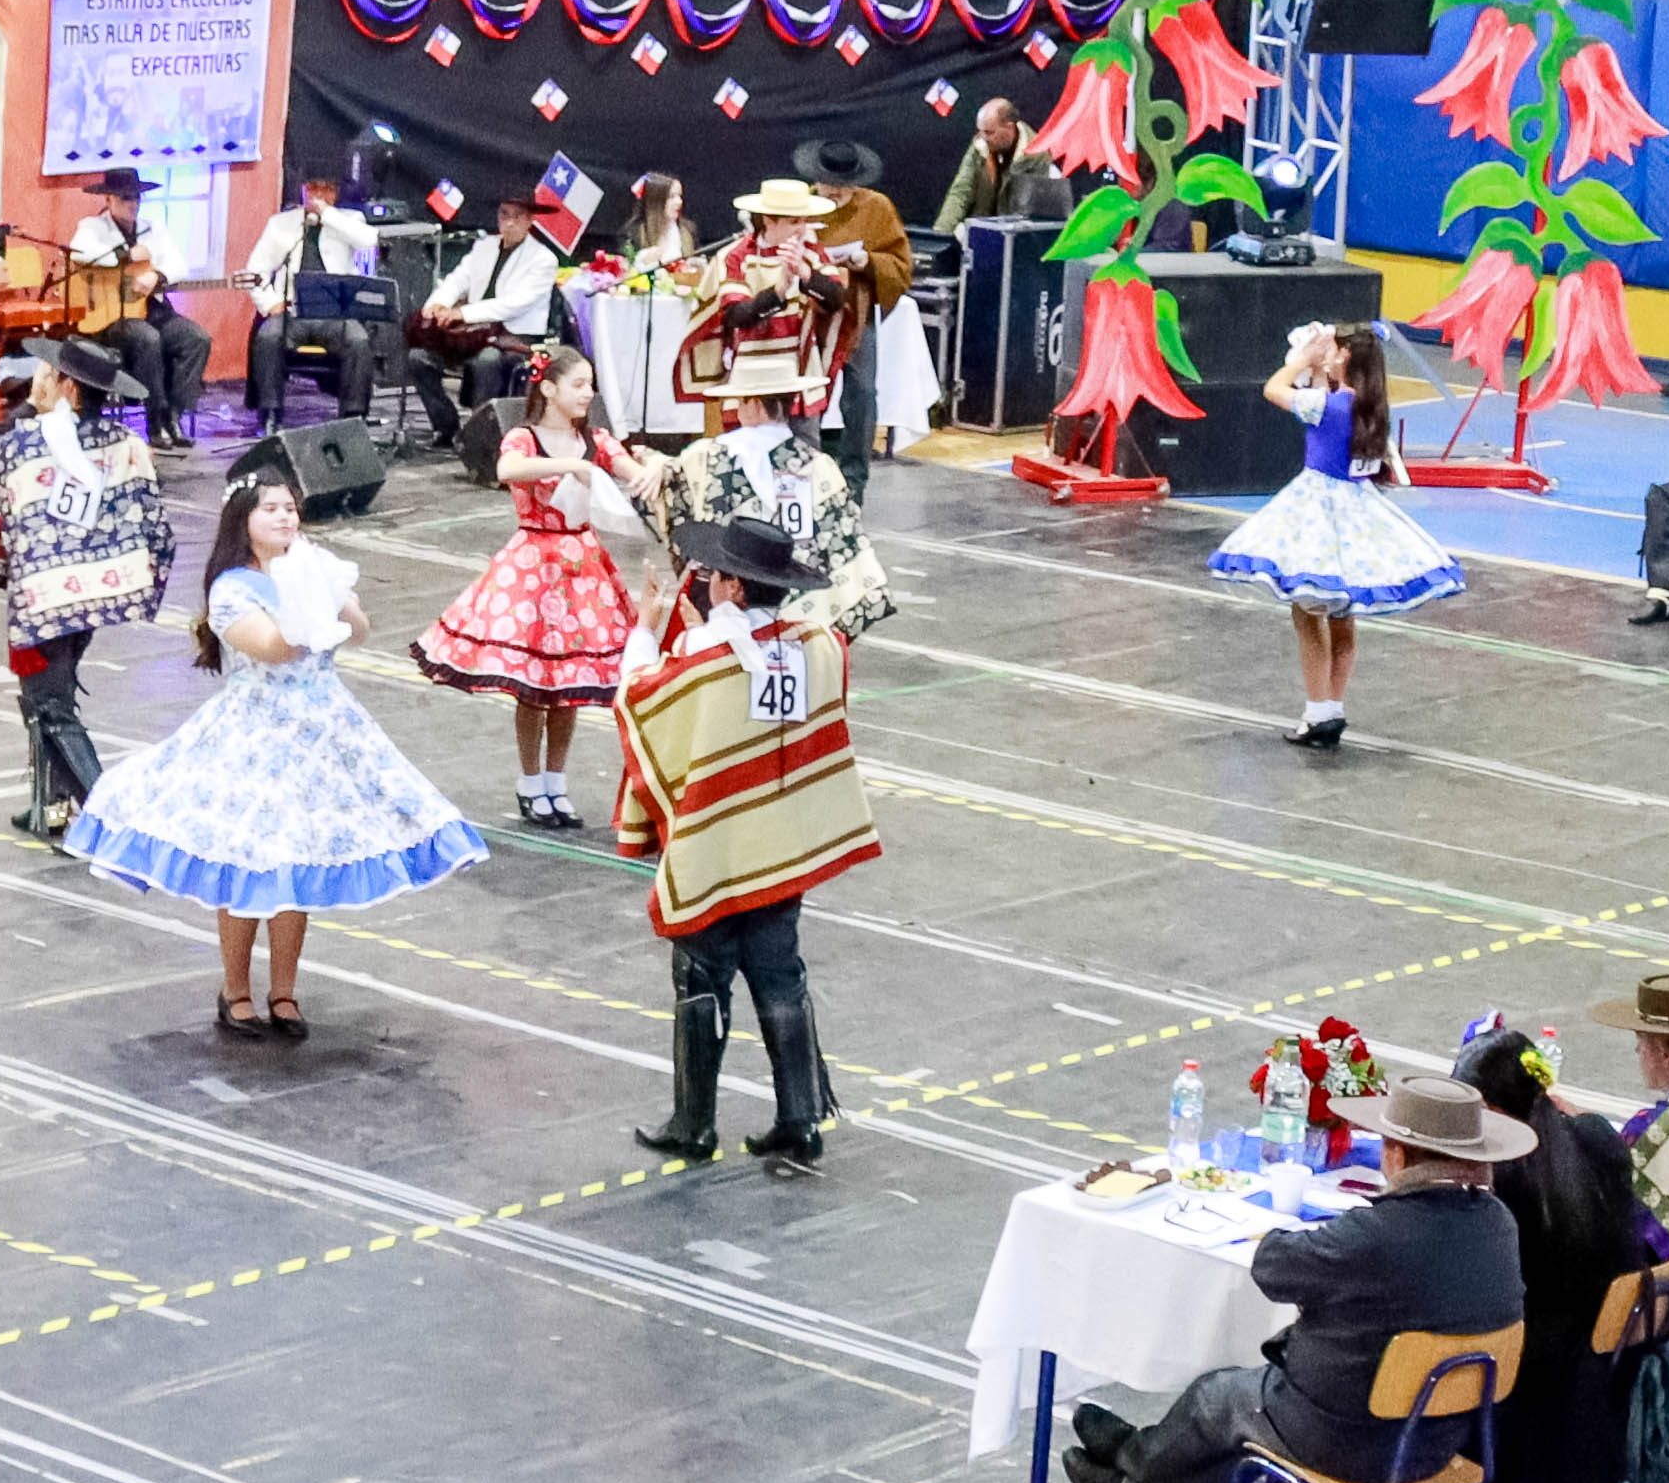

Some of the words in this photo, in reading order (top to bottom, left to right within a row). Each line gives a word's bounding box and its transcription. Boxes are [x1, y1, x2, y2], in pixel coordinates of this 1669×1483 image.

[149, 23, 170, 43] DE
[176, 18, 250, 42] NUESTRAS
[57, 482, 92, 522] 51
[757, 673, 796, 716] 48
